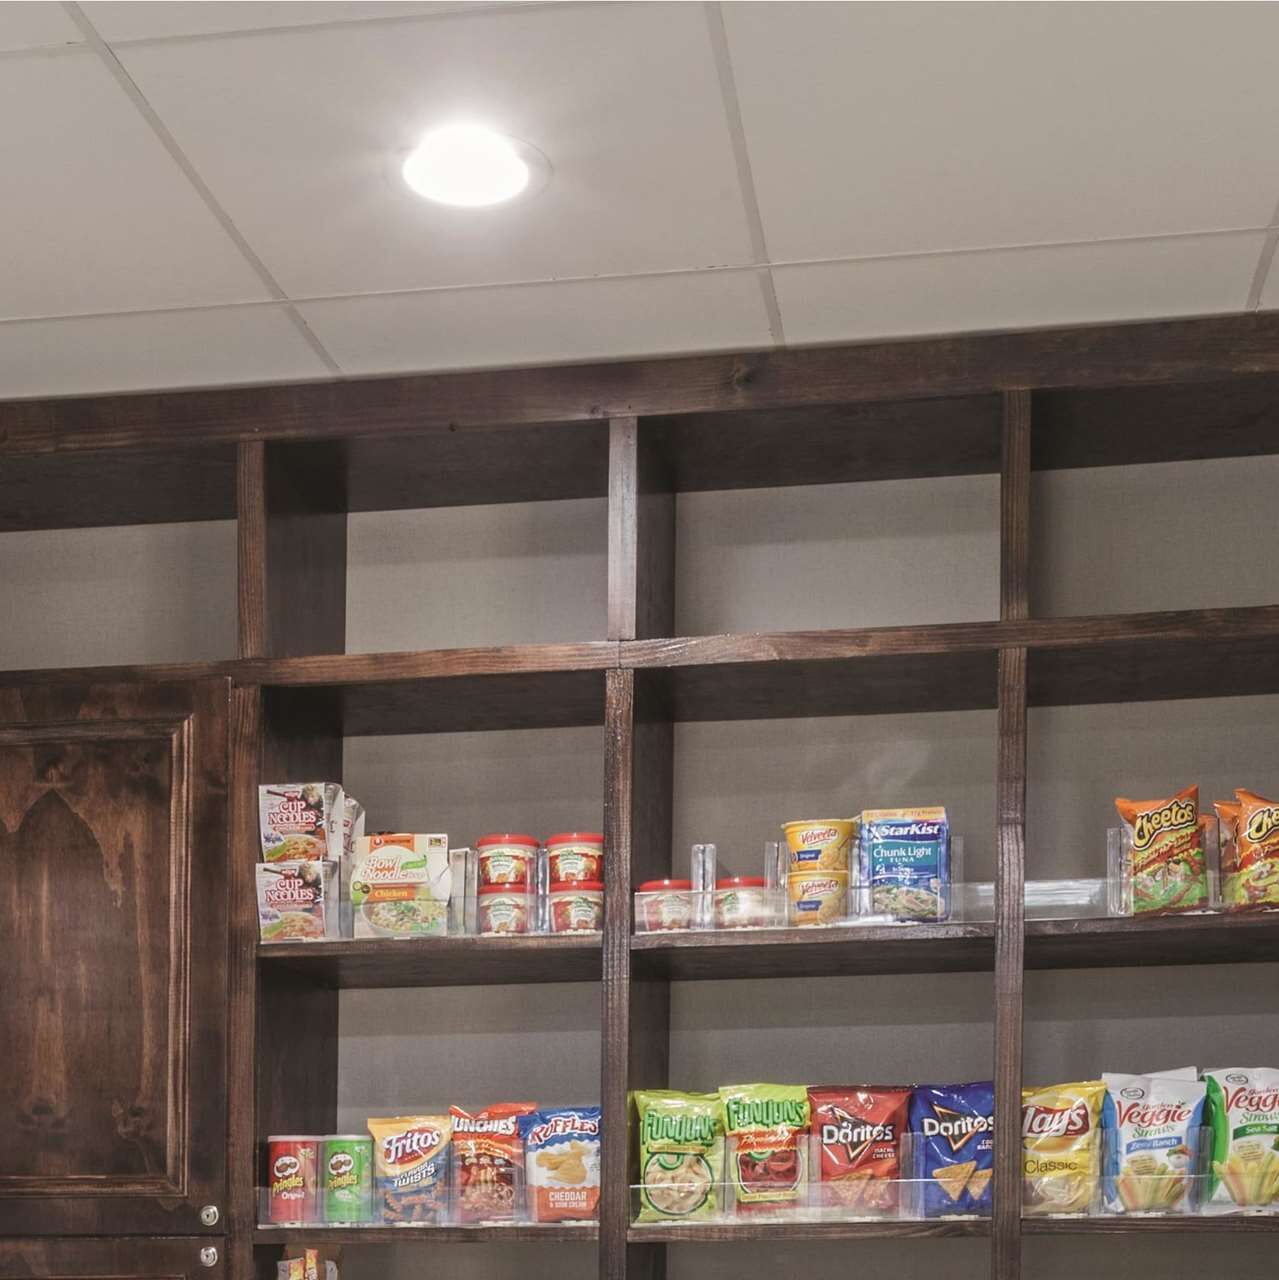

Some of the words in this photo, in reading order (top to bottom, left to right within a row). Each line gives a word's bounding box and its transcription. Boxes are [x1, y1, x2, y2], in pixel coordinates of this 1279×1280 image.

[279, 801, 306, 813] CUP
[268, 812, 316, 825] NOODLES
[1135, 803, 1194, 846] Cheetos
[881, 823, 939, 837] StarKist
[873, 846, 907, 857] Chunk
[908, 846, 932, 858] Light
[266, 889, 314, 902] NOODLES
[277, 880, 304, 891] CUP
[727, 1097, 805, 1131] FUNYUNS
[1022, 1102, 1084, 1137] Lay's
[1116, 1101, 1192, 1128] Veggie
[528, 1116, 599, 1145] RUFFLES
[642, 1111, 716, 1146] FUNYUNS
[822, 1123, 895, 1144] Doritos
[923, 1116, 994, 1136] Doritos
[383, 1130, 441, 1164] Fritos
[393, 1163, 436, 1187] TWISTS
[1024, 1159, 1078, 1174] Classic
[273, 1176, 304, 1196] Pringles
[549, 1192, 587, 1200] CHEDDAR
